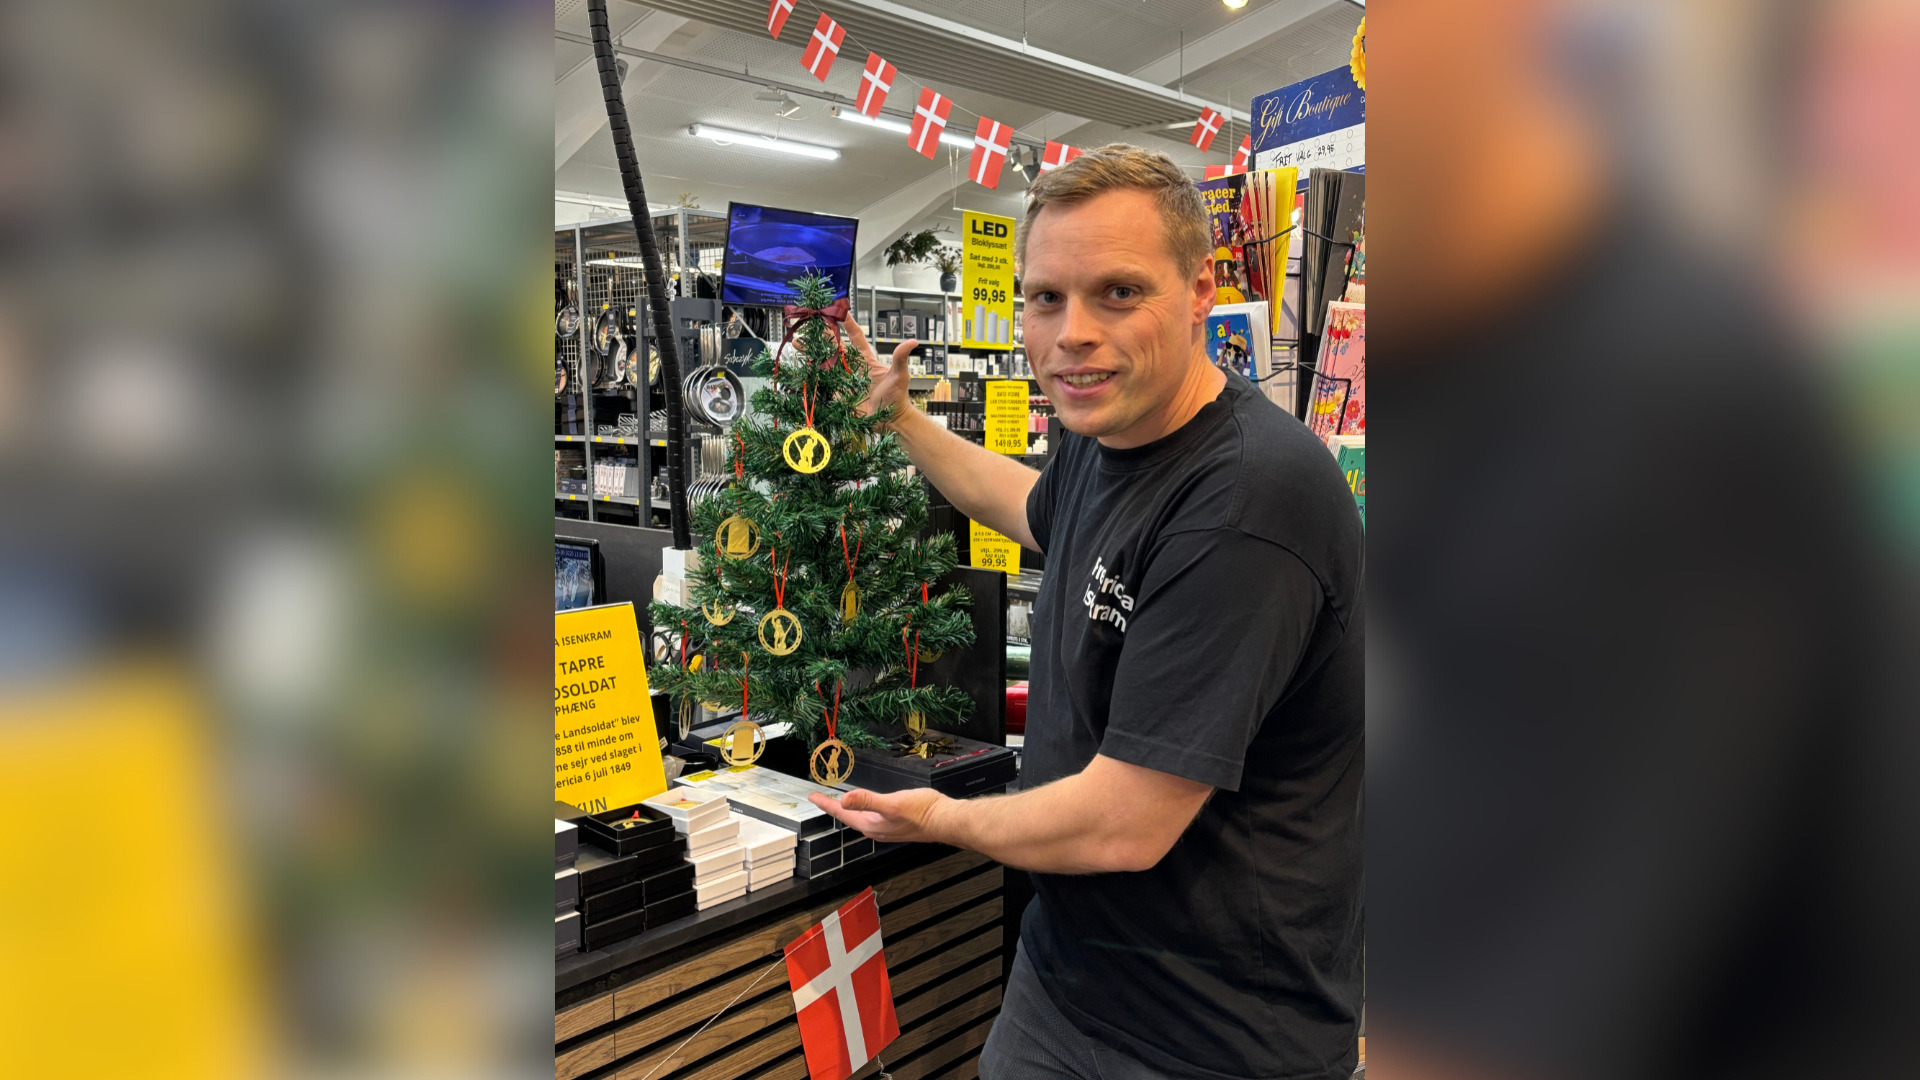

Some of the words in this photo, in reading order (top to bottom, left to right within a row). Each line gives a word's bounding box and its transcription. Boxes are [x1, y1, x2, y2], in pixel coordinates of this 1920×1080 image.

[1254, 96, 1284, 150] Gift
[1286, 82, 1352, 124] Boutique
[1201, 188, 1236, 201] racer
[972, 219, 1008, 238] LED
[973, 287, 1006, 304] 99,95
[982, 558, 1007, 568] 99,95
[562, 630, 612, 646] ISENKRAM
[559, 656, 605, 675] TAPRE
[555, 699, 596, 716] PHÆNG
[621, 715, 640, 726] blev
[574, 741, 585, 752] til
[587, 735, 617, 749] minde
[619, 732, 634, 741] om
[571, 757, 588, 769] sejr
[590, 752, 607, 764] ved
[610, 746, 637, 758] slaget
[638, 743, 642, 752] i
[555, 774, 582, 789] ericia
[585, 772, 591, 781] 6
[593, 767, 608, 782] juli
[610, 762, 631, 774] 1849
